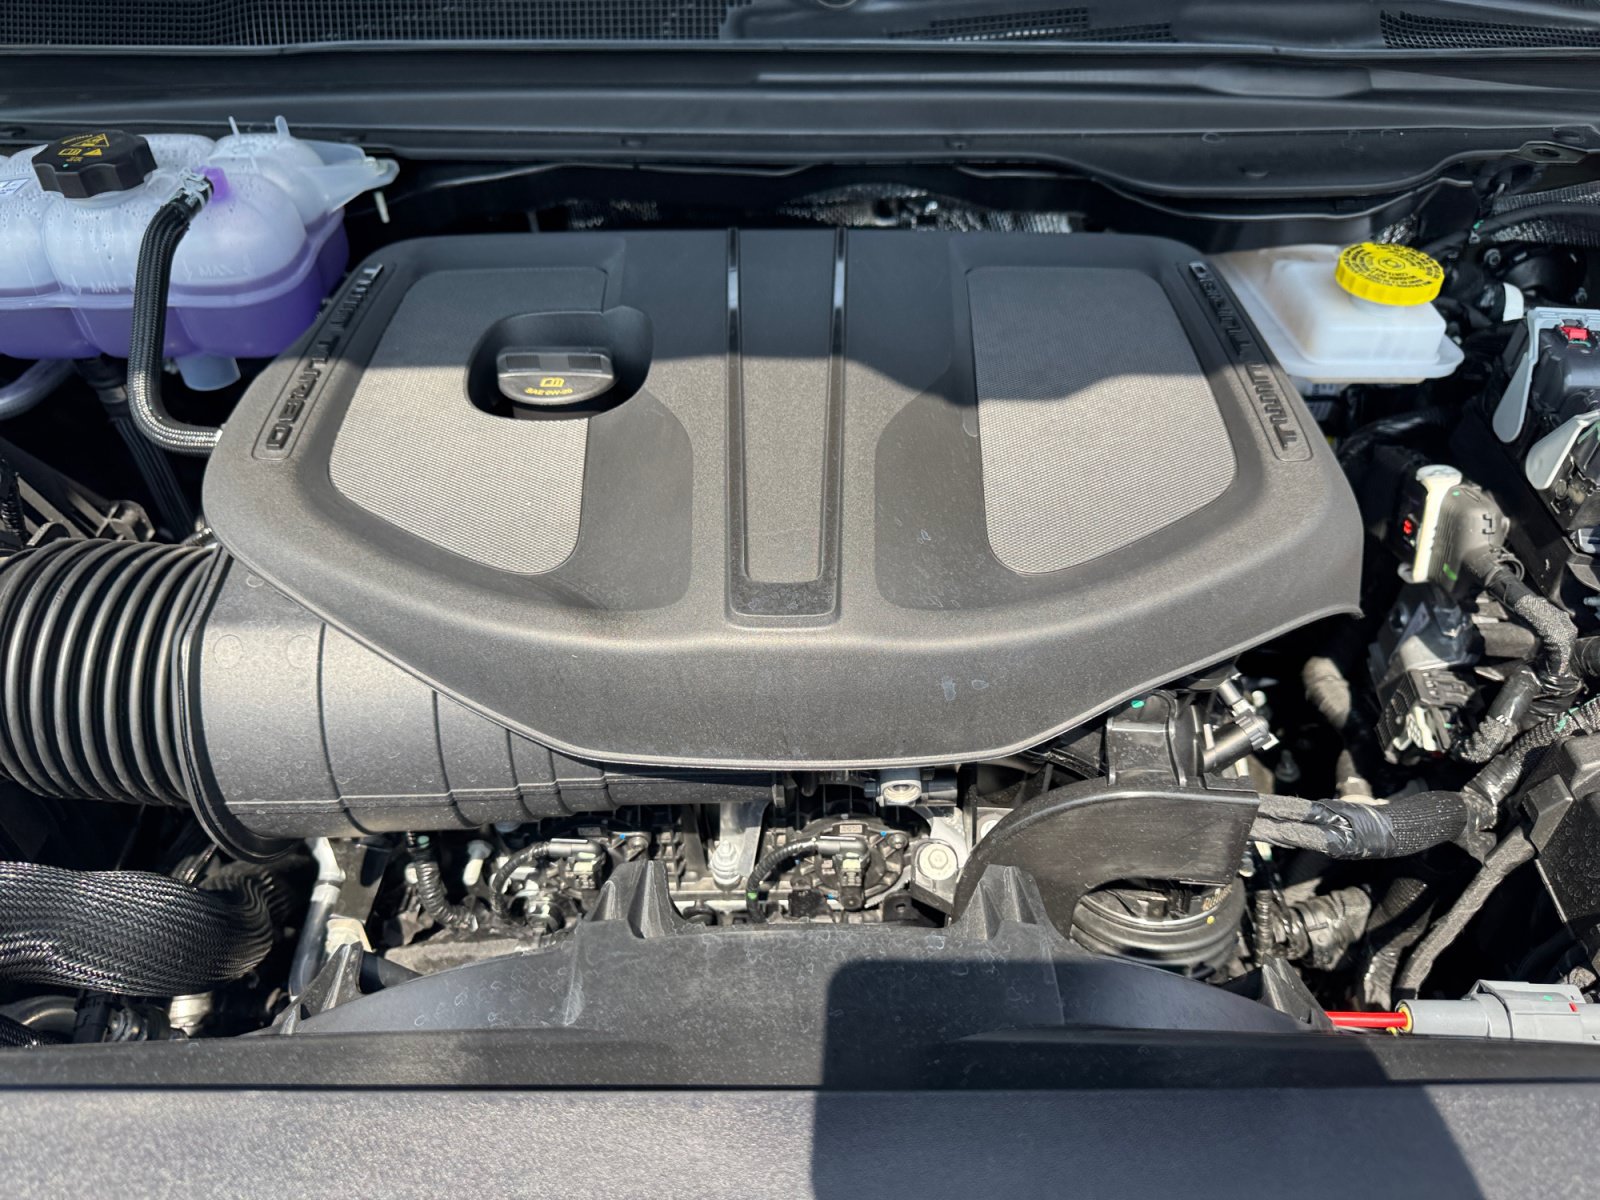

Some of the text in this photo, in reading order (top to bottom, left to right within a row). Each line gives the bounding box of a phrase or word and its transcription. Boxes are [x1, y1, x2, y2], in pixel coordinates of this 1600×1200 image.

[199, 263, 234, 278] MAX
[90, 281, 120, 293] MIN
[524, 387, 544, 396] SAE
